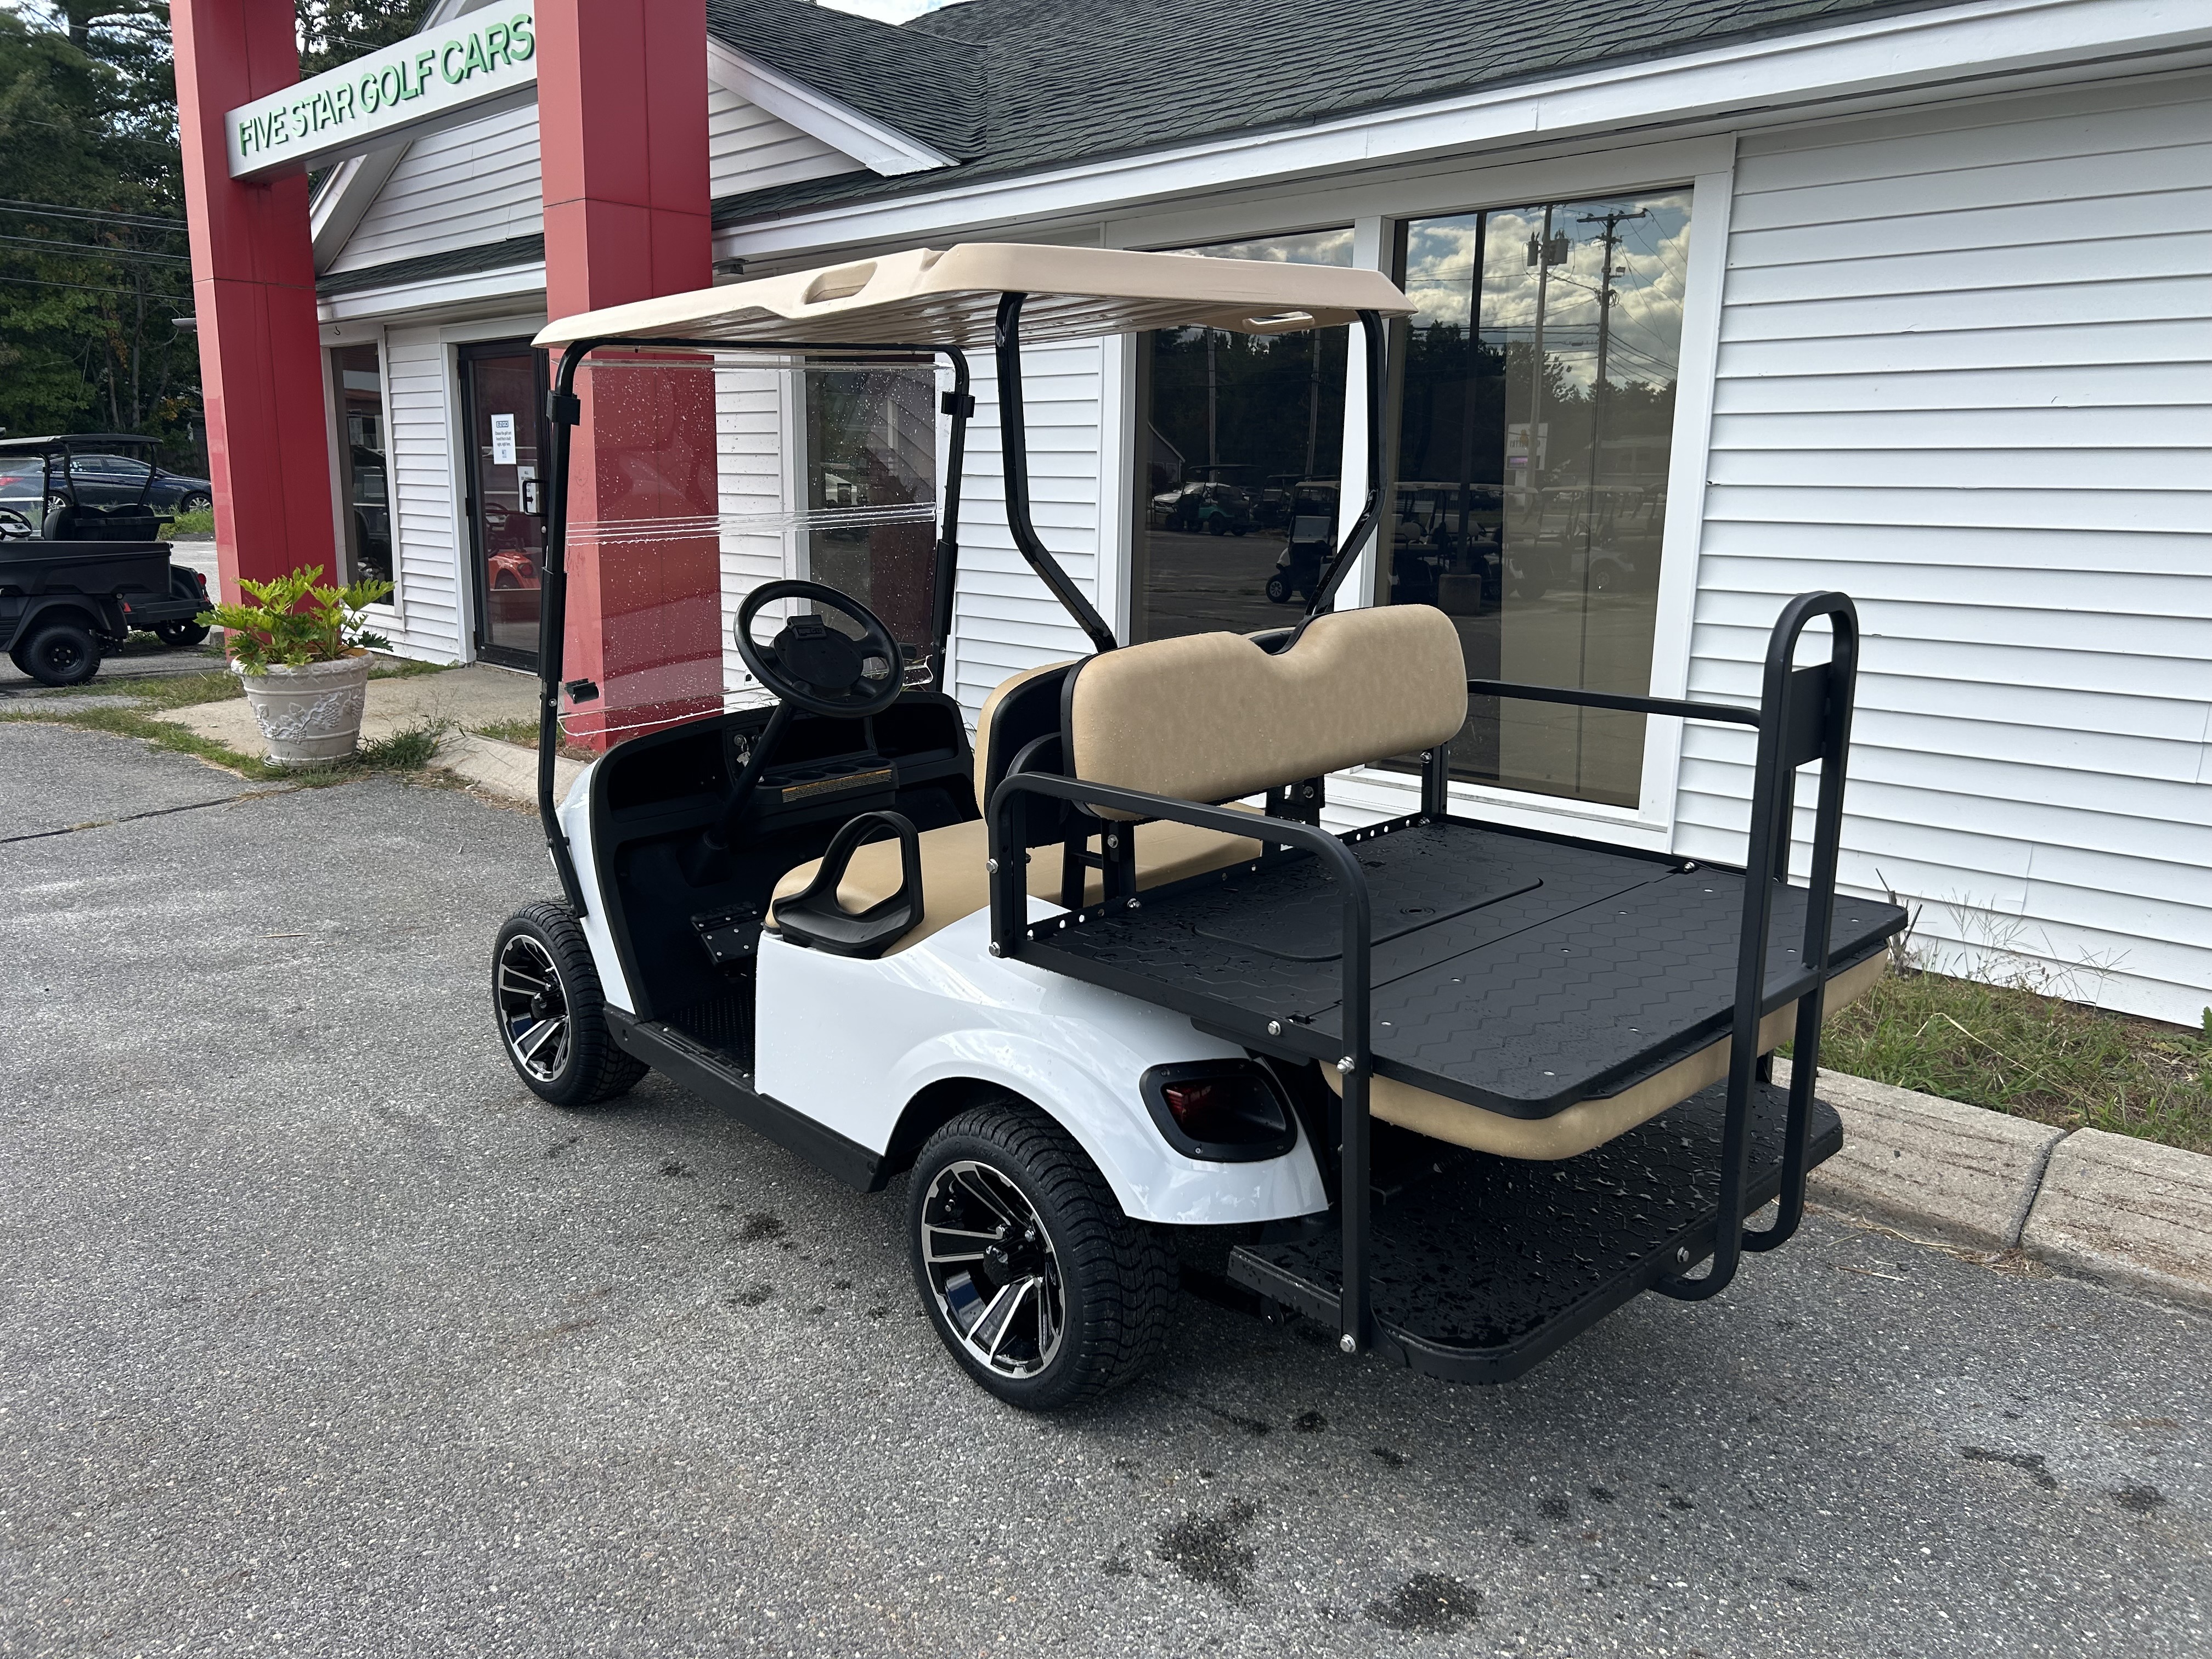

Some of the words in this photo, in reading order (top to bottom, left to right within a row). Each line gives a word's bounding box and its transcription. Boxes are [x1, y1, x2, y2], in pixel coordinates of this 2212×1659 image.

[239, 107, 288, 157] FIVE
[291, 82, 354, 137] STAR
[359, 49, 435, 114] GOLF
[441, 14, 535, 84] CARS
